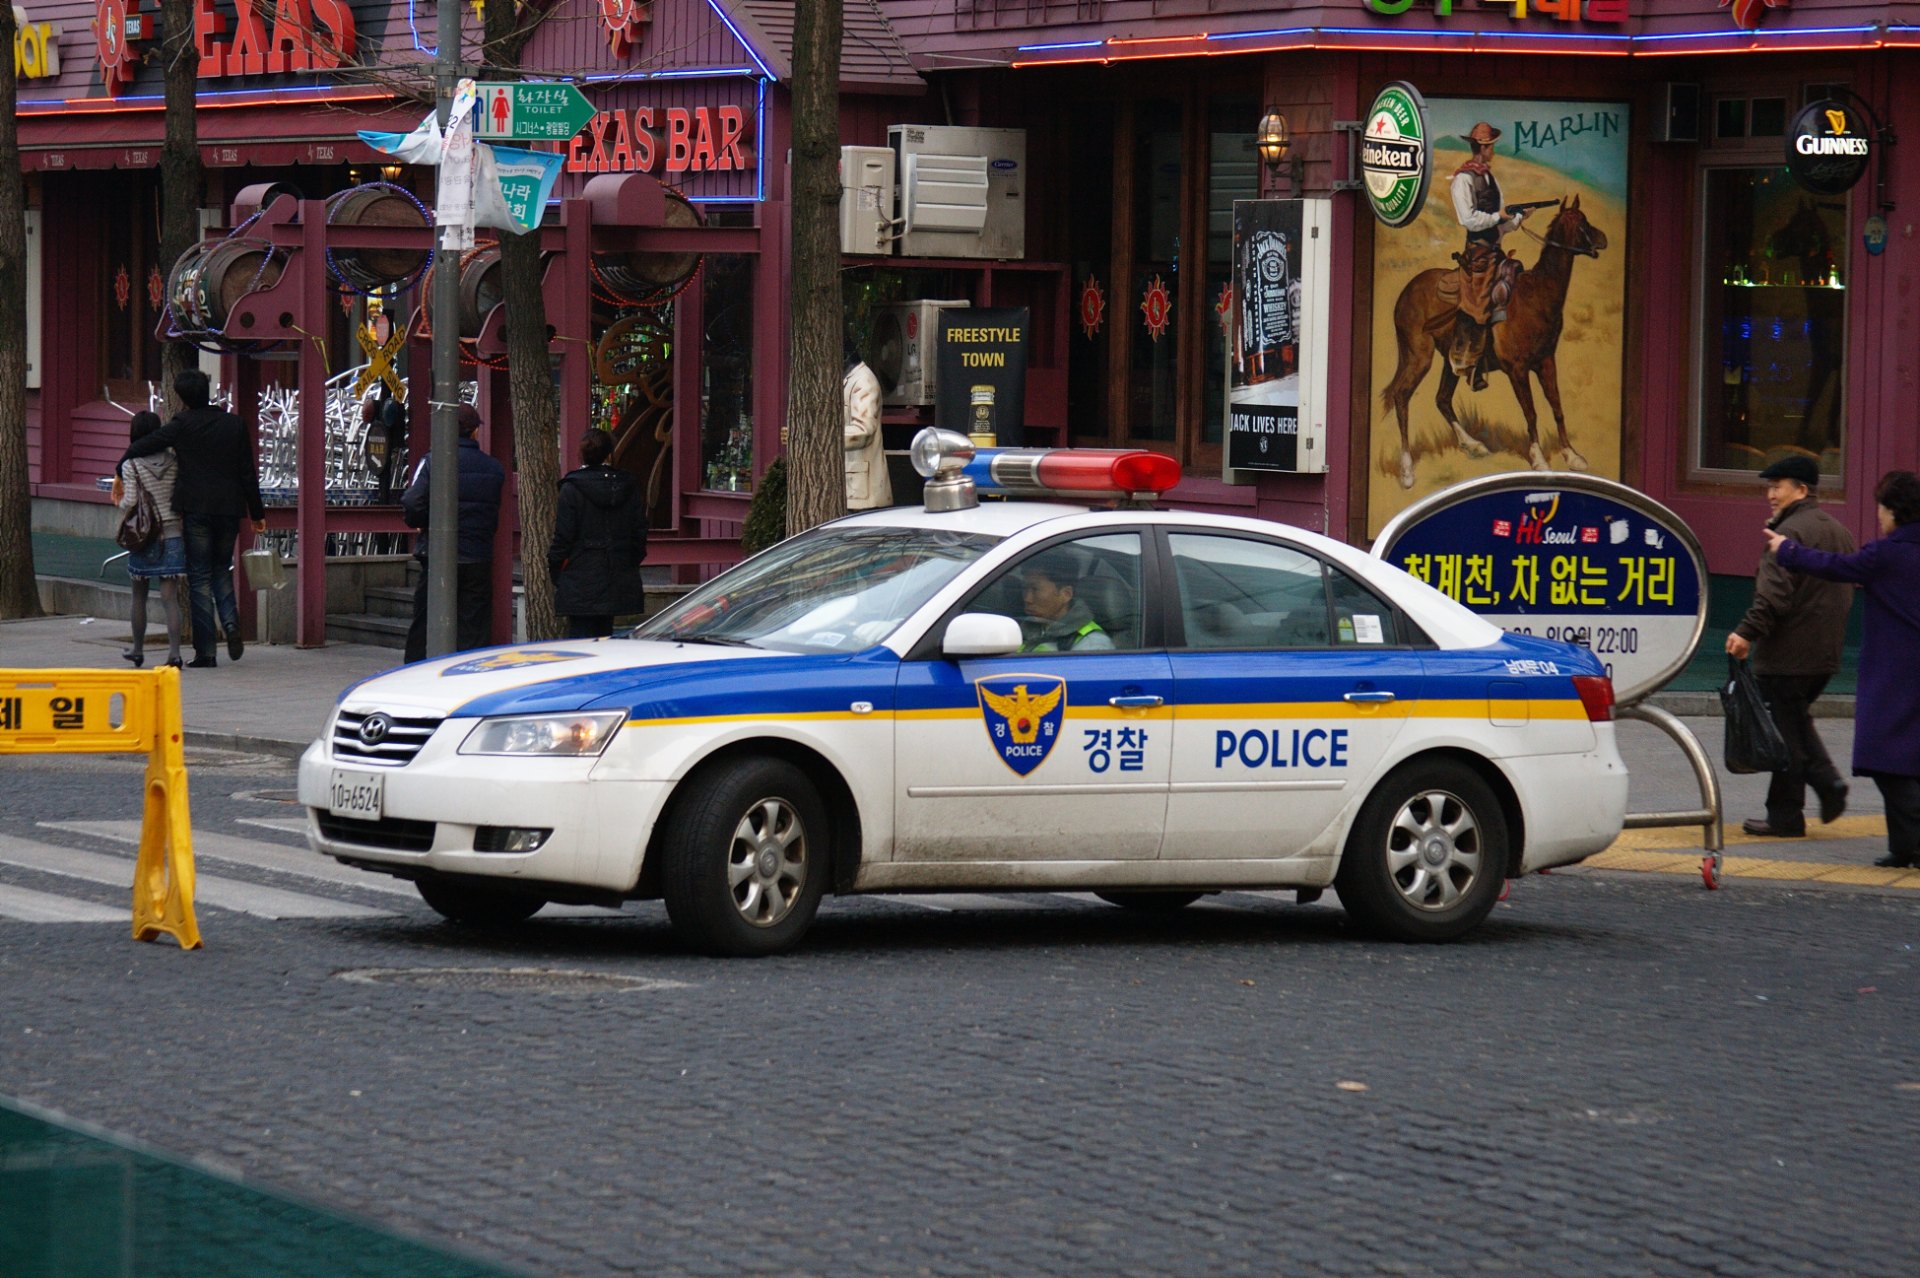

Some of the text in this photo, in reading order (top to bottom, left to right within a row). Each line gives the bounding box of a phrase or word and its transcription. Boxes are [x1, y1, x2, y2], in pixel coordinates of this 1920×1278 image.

[194, 0, 344, 78] EXAS
[516, 88, 569, 106] 화장실
[1394, 102, 1410, 127] BEER
[553, 105, 745, 173] EXAS BAR
[1514, 112, 1619, 155] MARLIN
[1796, 134, 1869, 156] GUINNESS
[132, 151, 149, 164] TEXAS
[316, 146, 334, 160] TEXAS
[1363, 143, 1412, 168] eineken
[383, 328, 405, 362] ROAD
[946, 327, 1021, 343] FREESTYLE
[961, 352, 1005, 368] TOWN
[1230, 413, 1297, 435] JACK LIVES HERE
[369, 443, 385, 455] BAR
[1542, 525, 1578, 544] Seoul
[1508, 554, 1541, 606] 차
[1550, 554, 1608, 607] 없는
[1617, 556, 1675, 606] 거리
[1597, 627, 1638, 654] 22:00
[1005, 745, 1043, 758] POLICE
[1083, 726, 1149, 774] 경찰
[1215, 728, 1349, 768] POLICE
